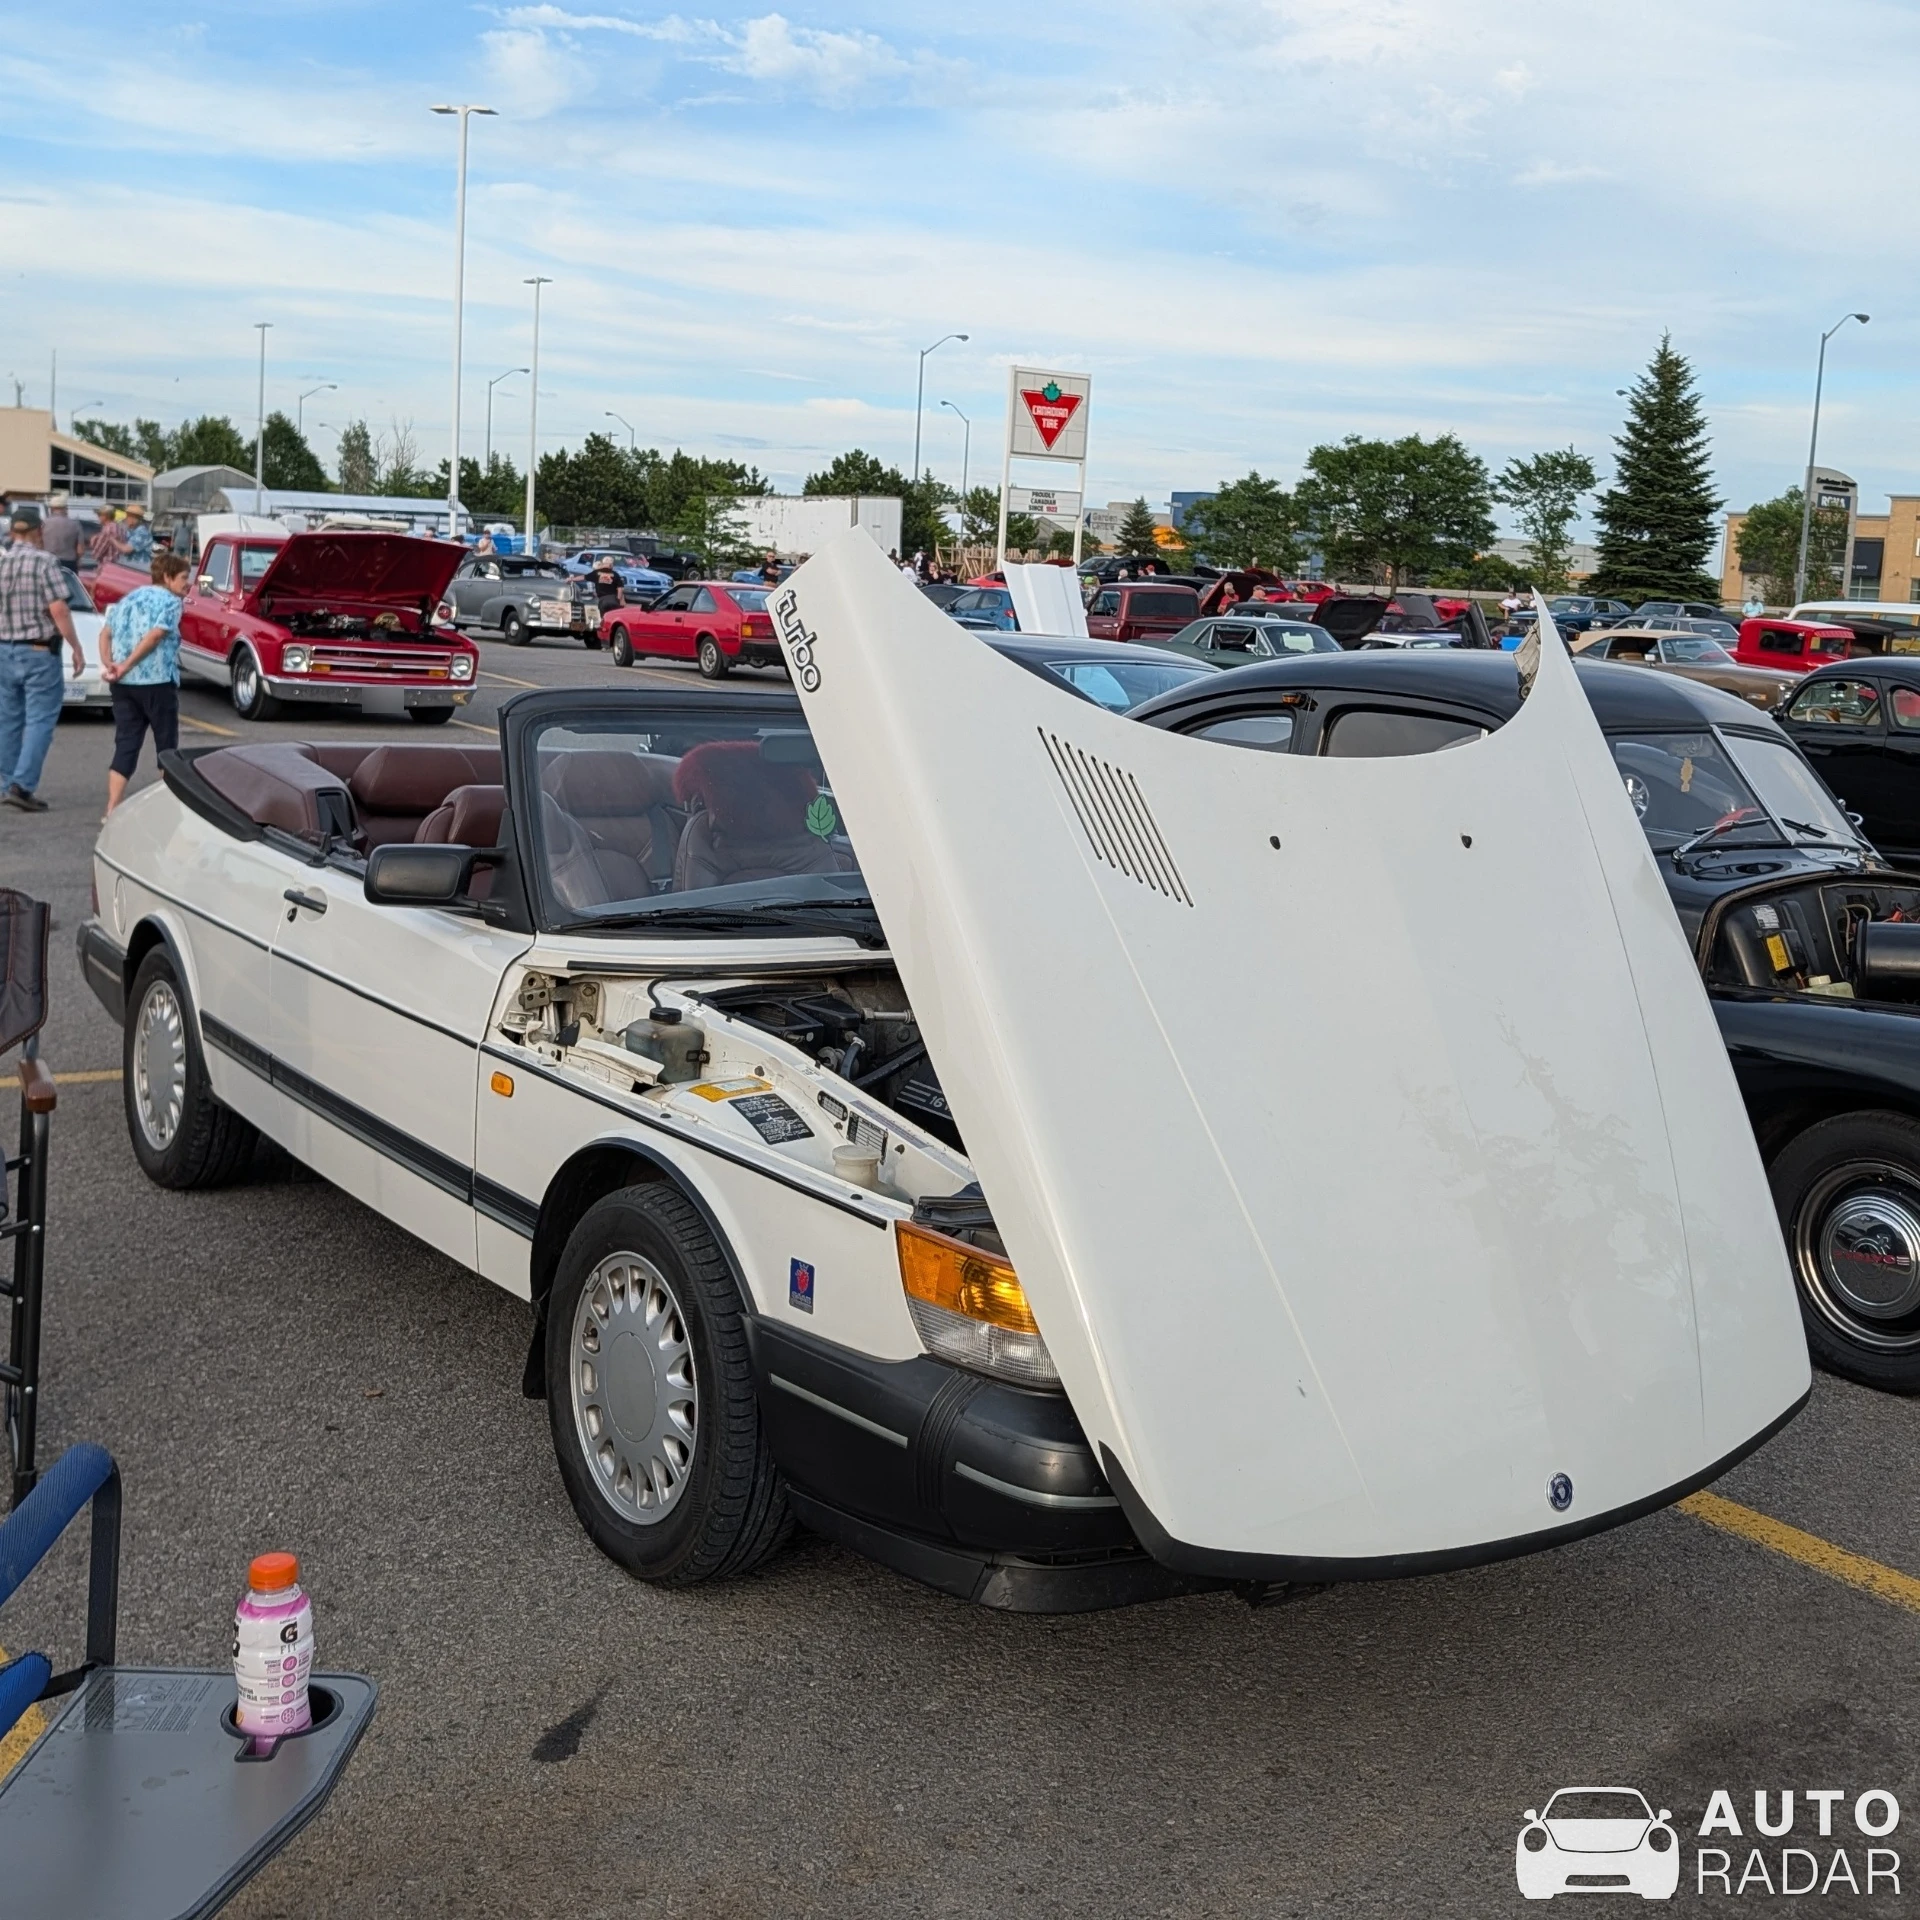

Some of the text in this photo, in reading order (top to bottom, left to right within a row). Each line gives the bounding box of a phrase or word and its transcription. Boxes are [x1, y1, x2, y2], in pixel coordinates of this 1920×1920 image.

[1032, 405, 1068, 418] CANADIAN
[1042, 418, 1058, 429] TIRE
[1092, 512, 1118, 522] Garden
[775, 589, 822, 693] turbo
[929, 1095, 945, 1108] 16
[280, 1621, 298, 1644] G
[280, 1643, 297, 1655] FIT
